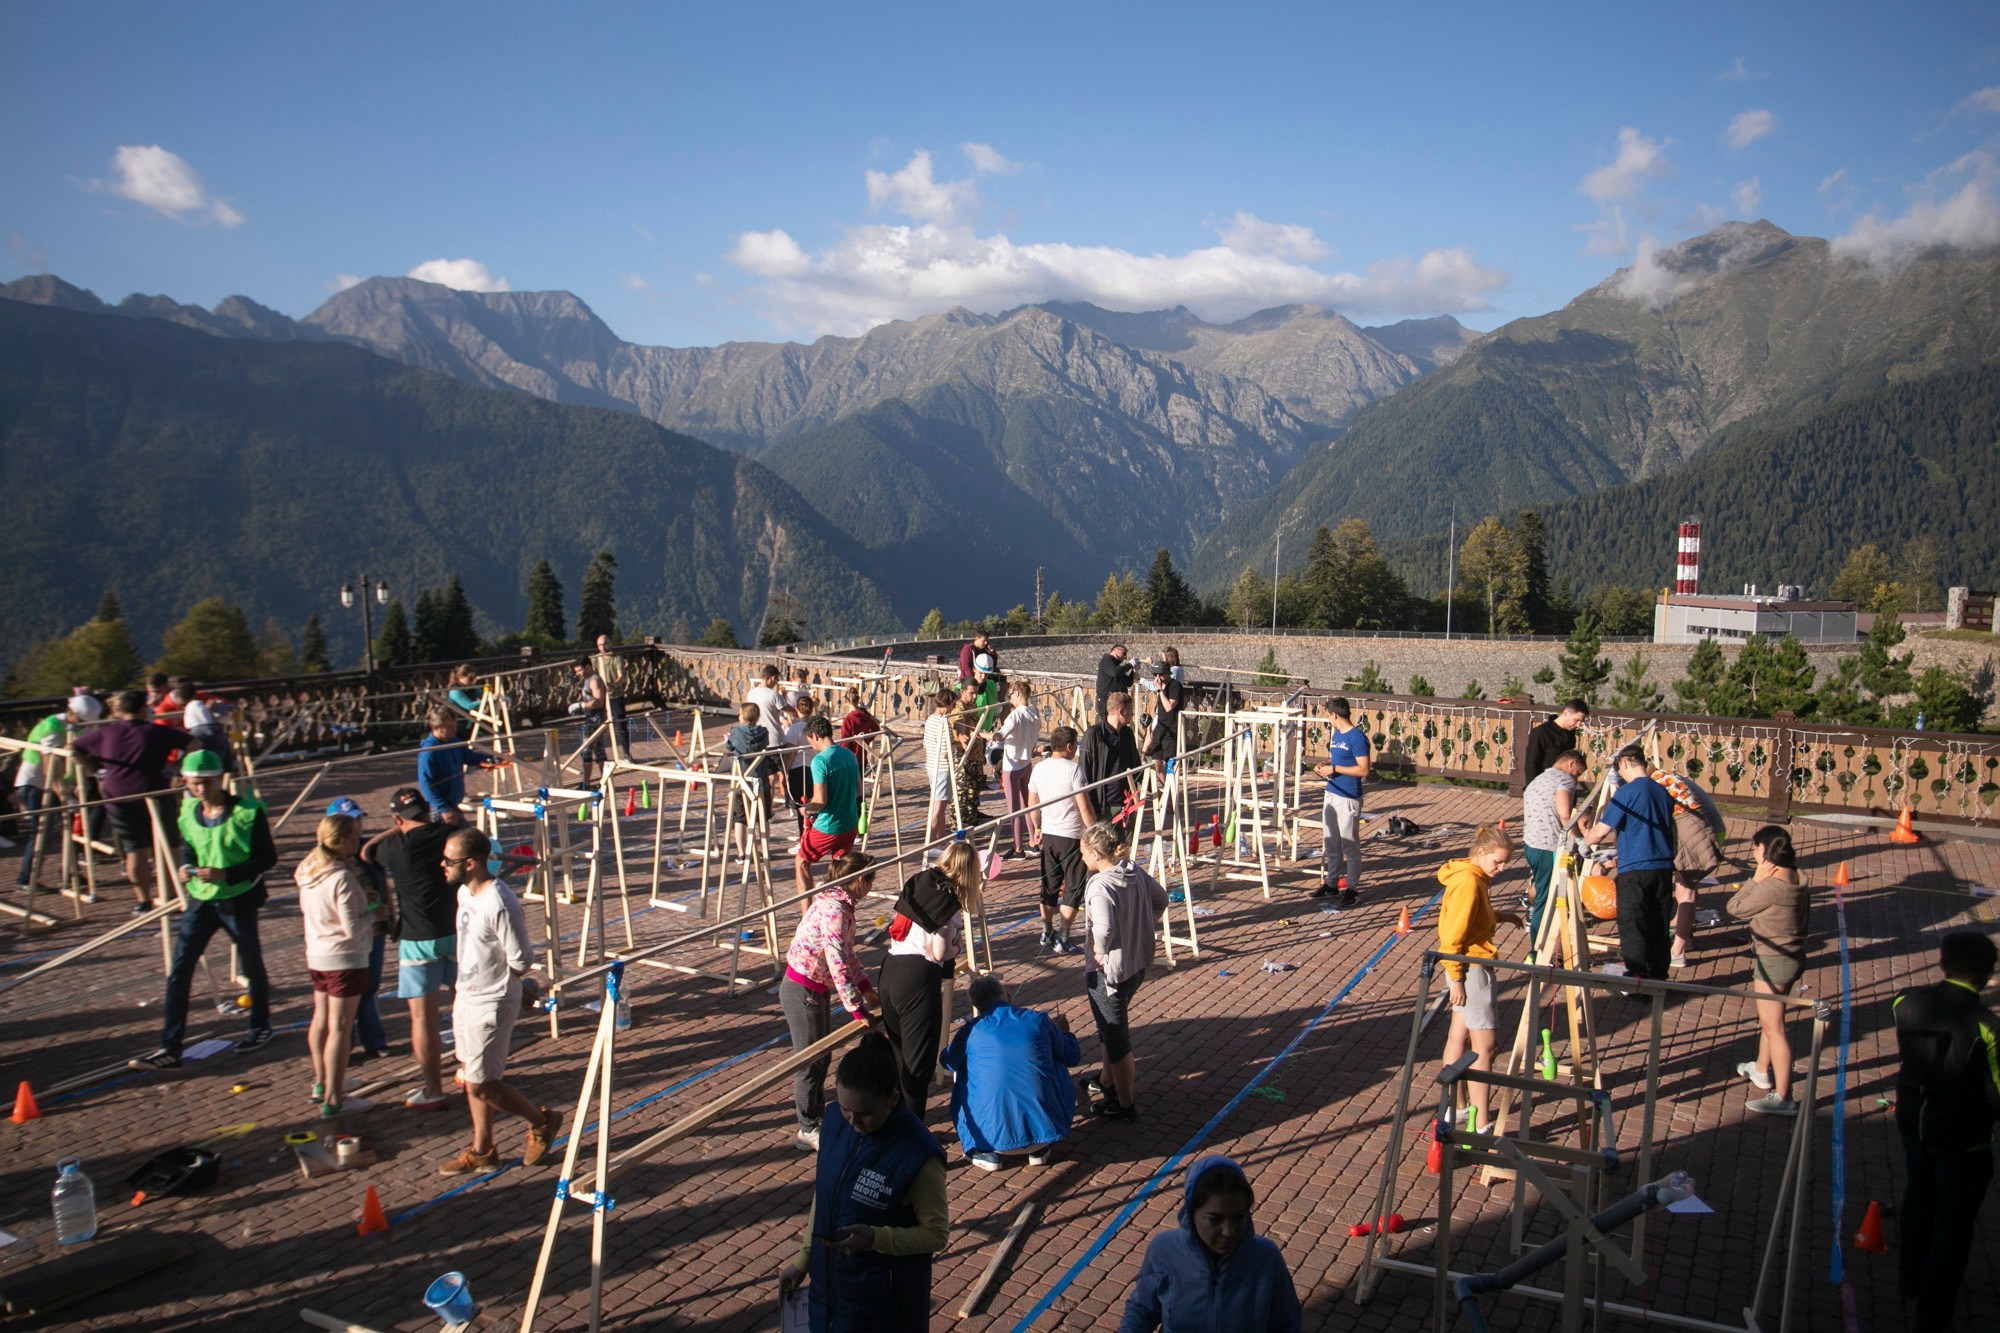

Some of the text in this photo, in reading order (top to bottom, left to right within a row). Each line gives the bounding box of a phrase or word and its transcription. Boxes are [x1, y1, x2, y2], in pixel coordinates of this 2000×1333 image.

[860, 1167, 886, 1184] КУБОК
[853, 1182, 880, 1199] НЕФТИ
[857, 1174, 893, 1196] ГАЗПРОМ
